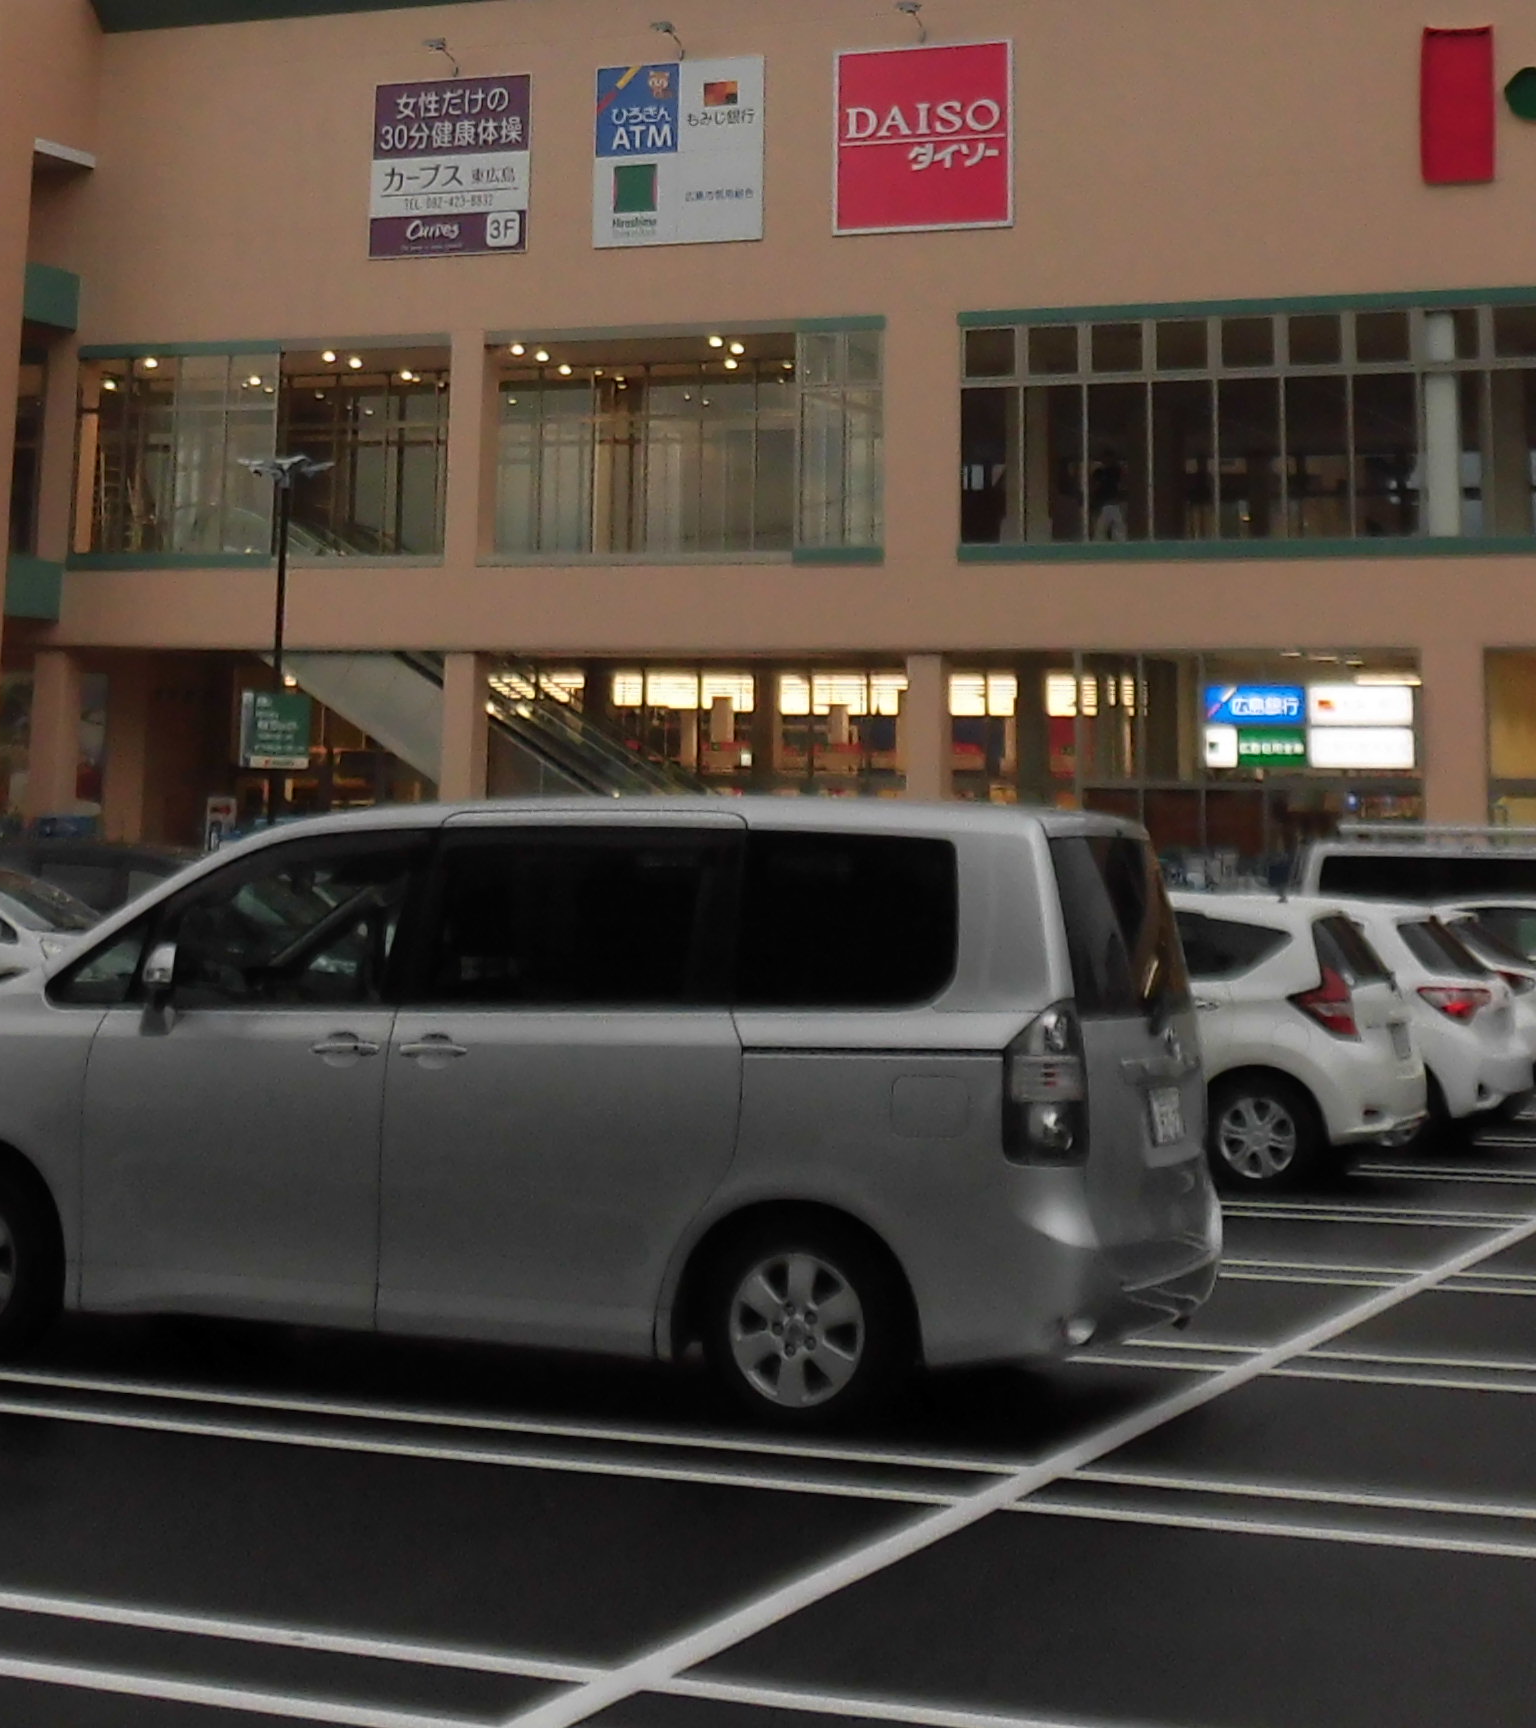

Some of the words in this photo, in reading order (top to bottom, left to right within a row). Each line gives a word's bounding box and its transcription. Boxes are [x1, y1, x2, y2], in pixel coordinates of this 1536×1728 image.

[395, 87, 509, 120] 女性だけの
[611, 105, 672, 125] ひろぎん
[687, 108, 756, 127] もみじ銀行
[845, 98, 1001, 140] DAISO
[380, 116, 523, 151] 30分健康体操
[611, 124, 673, 151] ATM
[908, 142, 1000, 171] ダイソー
[471, 166, 516, 185] 東広島
[489, 218, 517, 240] 3F
